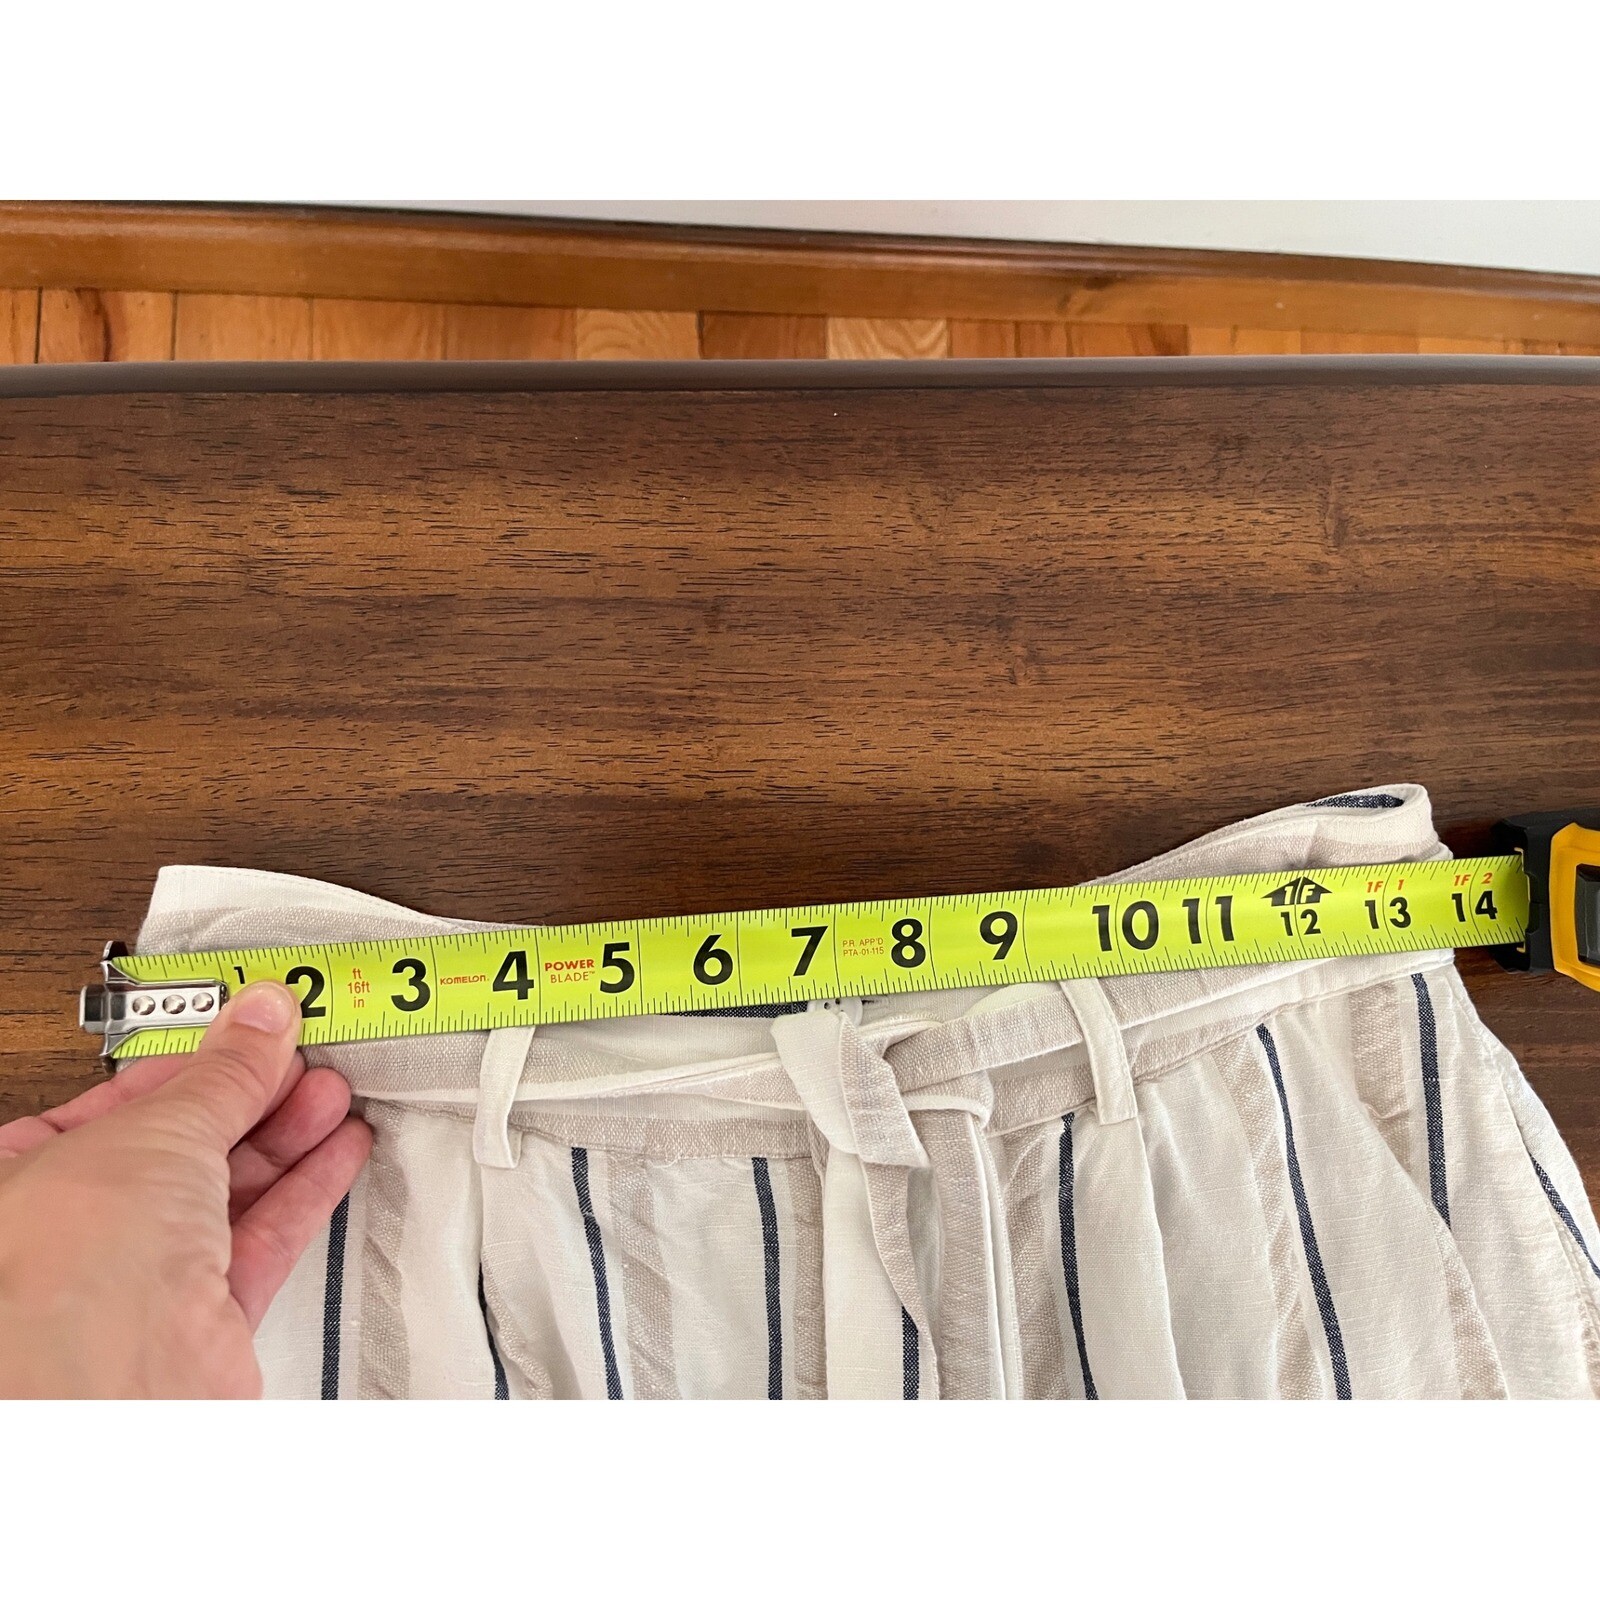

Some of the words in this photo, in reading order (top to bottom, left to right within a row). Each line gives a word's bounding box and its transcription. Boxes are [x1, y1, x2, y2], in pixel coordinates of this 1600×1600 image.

[1397, 879, 1405, 890] 1
[1481, 872, 1493, 884] 2
[1182, 895, 1235, 944] 11
[1280, 909, 1321, 936] 12
[1364, 897, 1411, 929] 13
[1451, 891, 1497, 922] 14
[979, 911, 1018, 960] 9
[1092, 900, 1159, 951] 10
[791, 926, 829, 976] 7
[843, 947, 884, 957] PTA-01-115
[891, 918, 926, 968] 8
[233, 966, 245, 984] 1
[352, 968, 362, 979] ft
[492, 950, 535, 1000] 4
[544, 959, 595, 972] POWER
[599, 942, 635, 993] 5
[693, 934, 734, 985] 6
[285, 966, 327, 1018] 2
[347, 982, 371, 993] 16ft
[390, 958, 431, 1011] 3
[353, 997, 365, 1008] in
